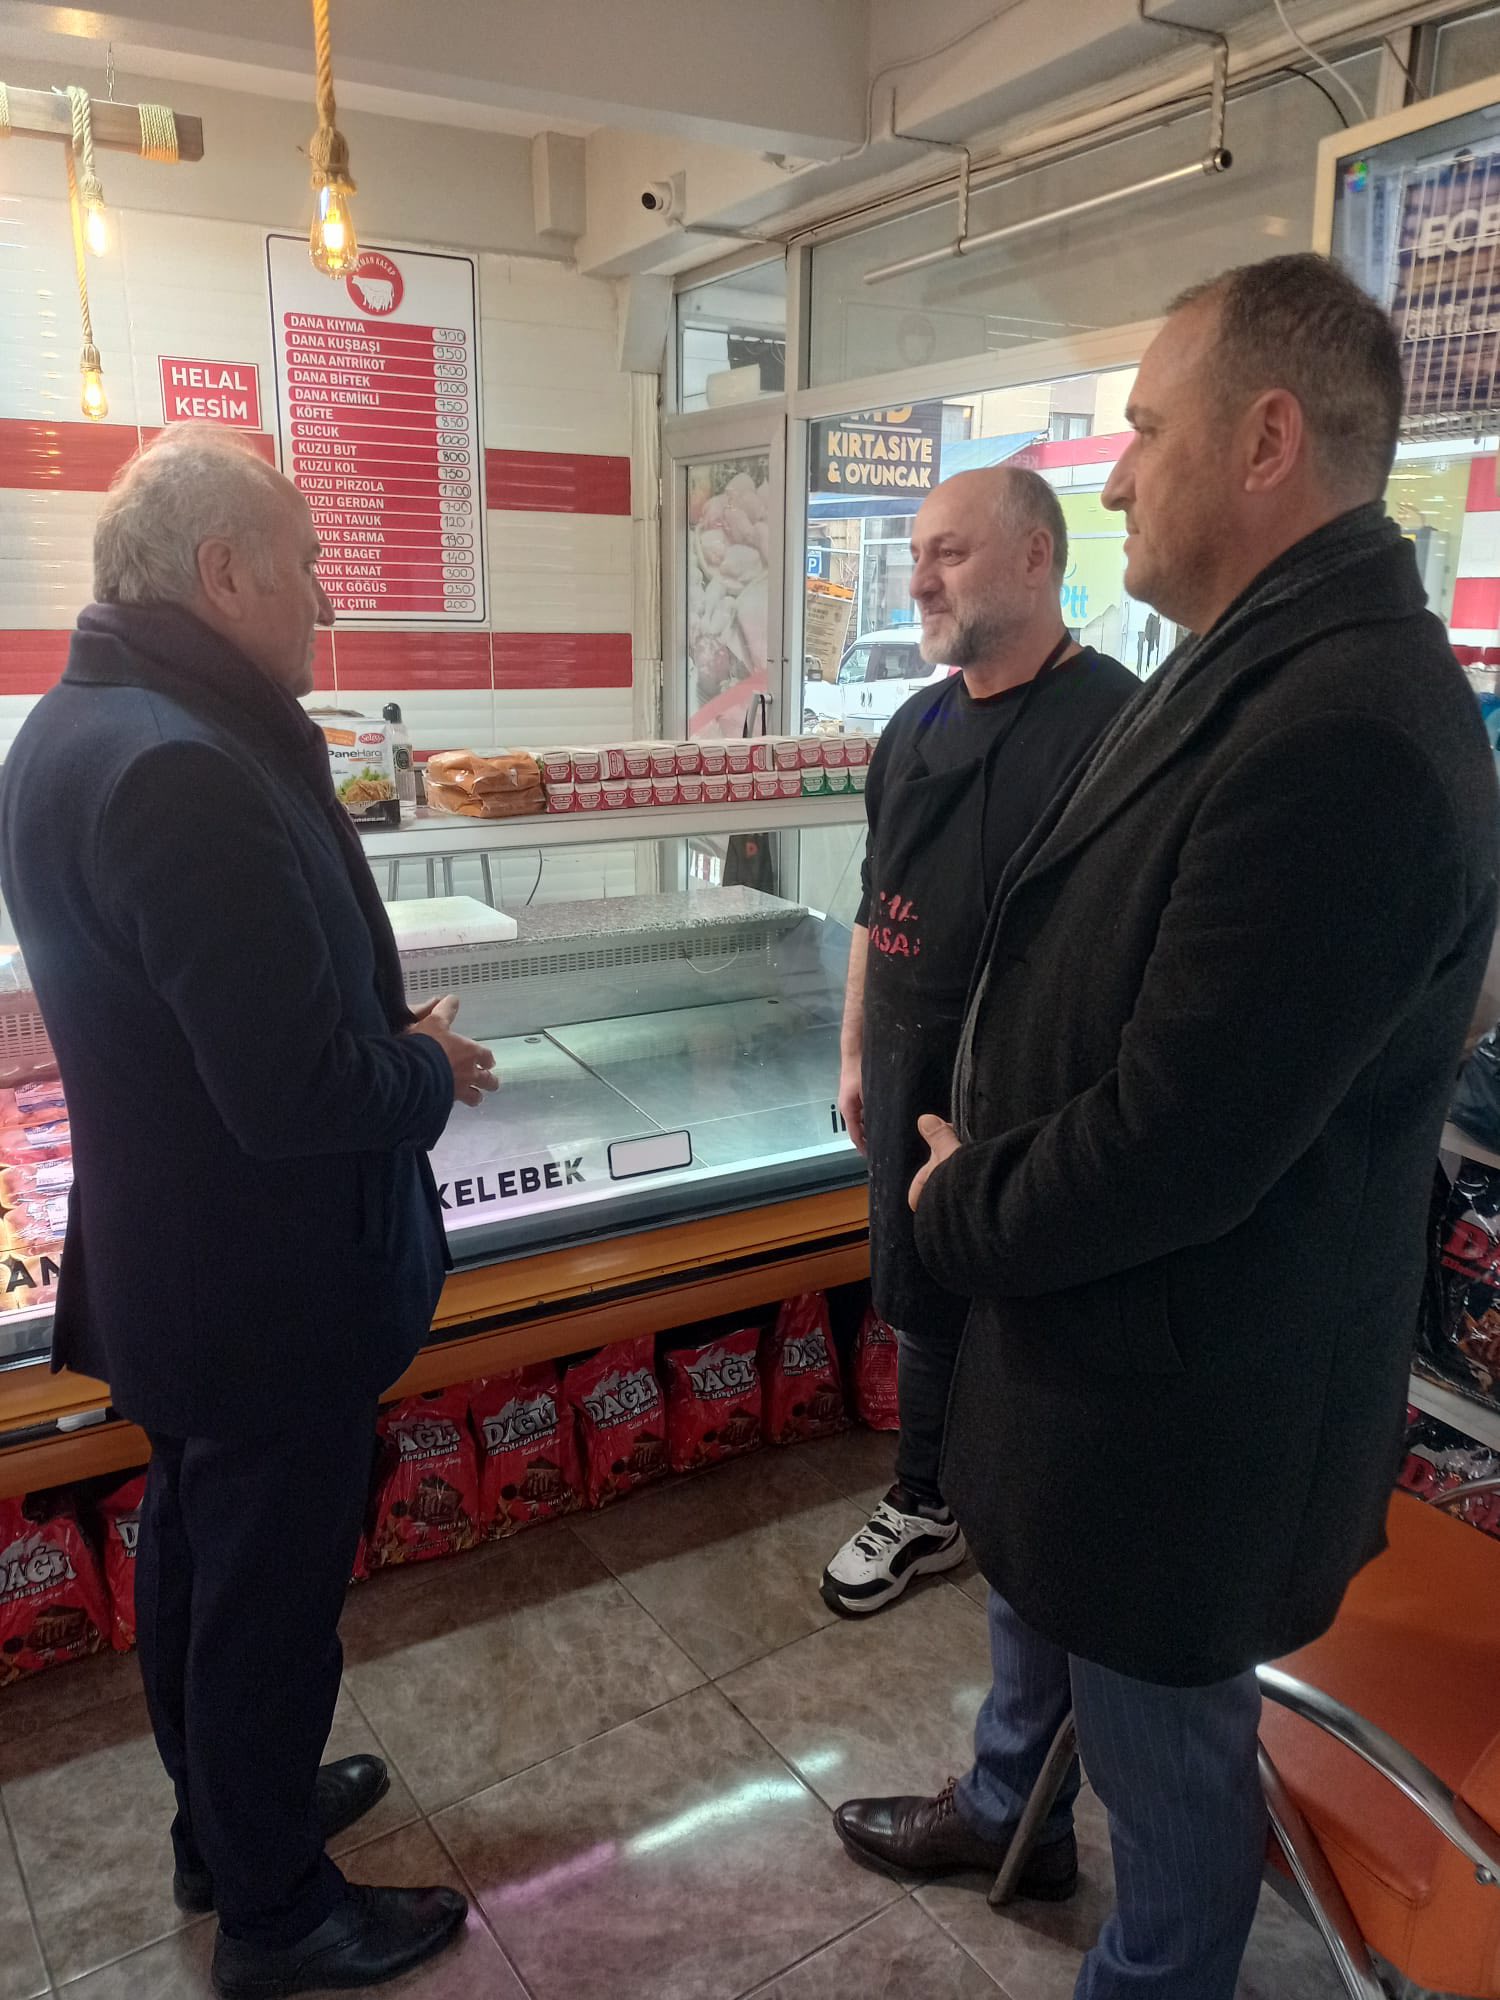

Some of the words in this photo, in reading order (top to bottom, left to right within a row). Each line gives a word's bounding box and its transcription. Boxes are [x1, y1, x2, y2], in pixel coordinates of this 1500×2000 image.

[291, 315, 324, 330] DANA
[327, 319, 365, 333] KIYMA
[292, 334, 326, 348] DANA
[329, 337, 380, 355] KUŞBAŞI
[437, 347, 462, 360] 950
[293, 352, 326, 366] DANA
[329, 354, 386, 370] ANTRİKOT
[437, 365, 464, 377] 1500
[171, 366, 248, 391] HELAL
[294, 371, 327, 384] DANA
[330, 371, 371, 387] BİFTEK
[437, 382, 466, 393] 1200
[175, 395, 248, 420] KESİM
[295, 388, 328, 401] DANA
[331, 389, 380, 405] KEMİKLİ
[438, 400, 462, 411] 750
[296, 405, 334, 419] KÖFTE
[297, 424, 340, 437] SUCUK
[439, 434, 467, 446] 1000
[298, 442, 331, 455] KUZU
[333, 444, 357, 456] BUT
[443, 451, 467, 463] 800
[827, 431, 933, 463] KIRTASİYE
[300, 460, 332, 472] KUZU
[335, 462, 358, 473] KOL
[828, 461, 841, 483] &
[845, 462, 932, 489] OYUNCAK
[301, 478, 333, 490] KUZU
[336, 477, 385, 492] PİRZOLA
[442, 484, 470, 497] 1700
[337, 497, 385, 509] GERDAN
[312, 511, 343, 524] ÜTÜN
[345, 514, 382, 525] TAVUK
[317, 530, 342, 542] VUK
[343, 531, 385, 543] SARMA
[320, 548, 342, 558] VUK
[344, 548, 382, 560] BAGET
[313, 565, 343, 575] AVUK
[345, 566, 382, 576] KANAT
[320, 582, 344, 591] VUK
[346, 580, 387, 593] GÖĞÜS
[347, 598, 377, 610] ÇITIR
